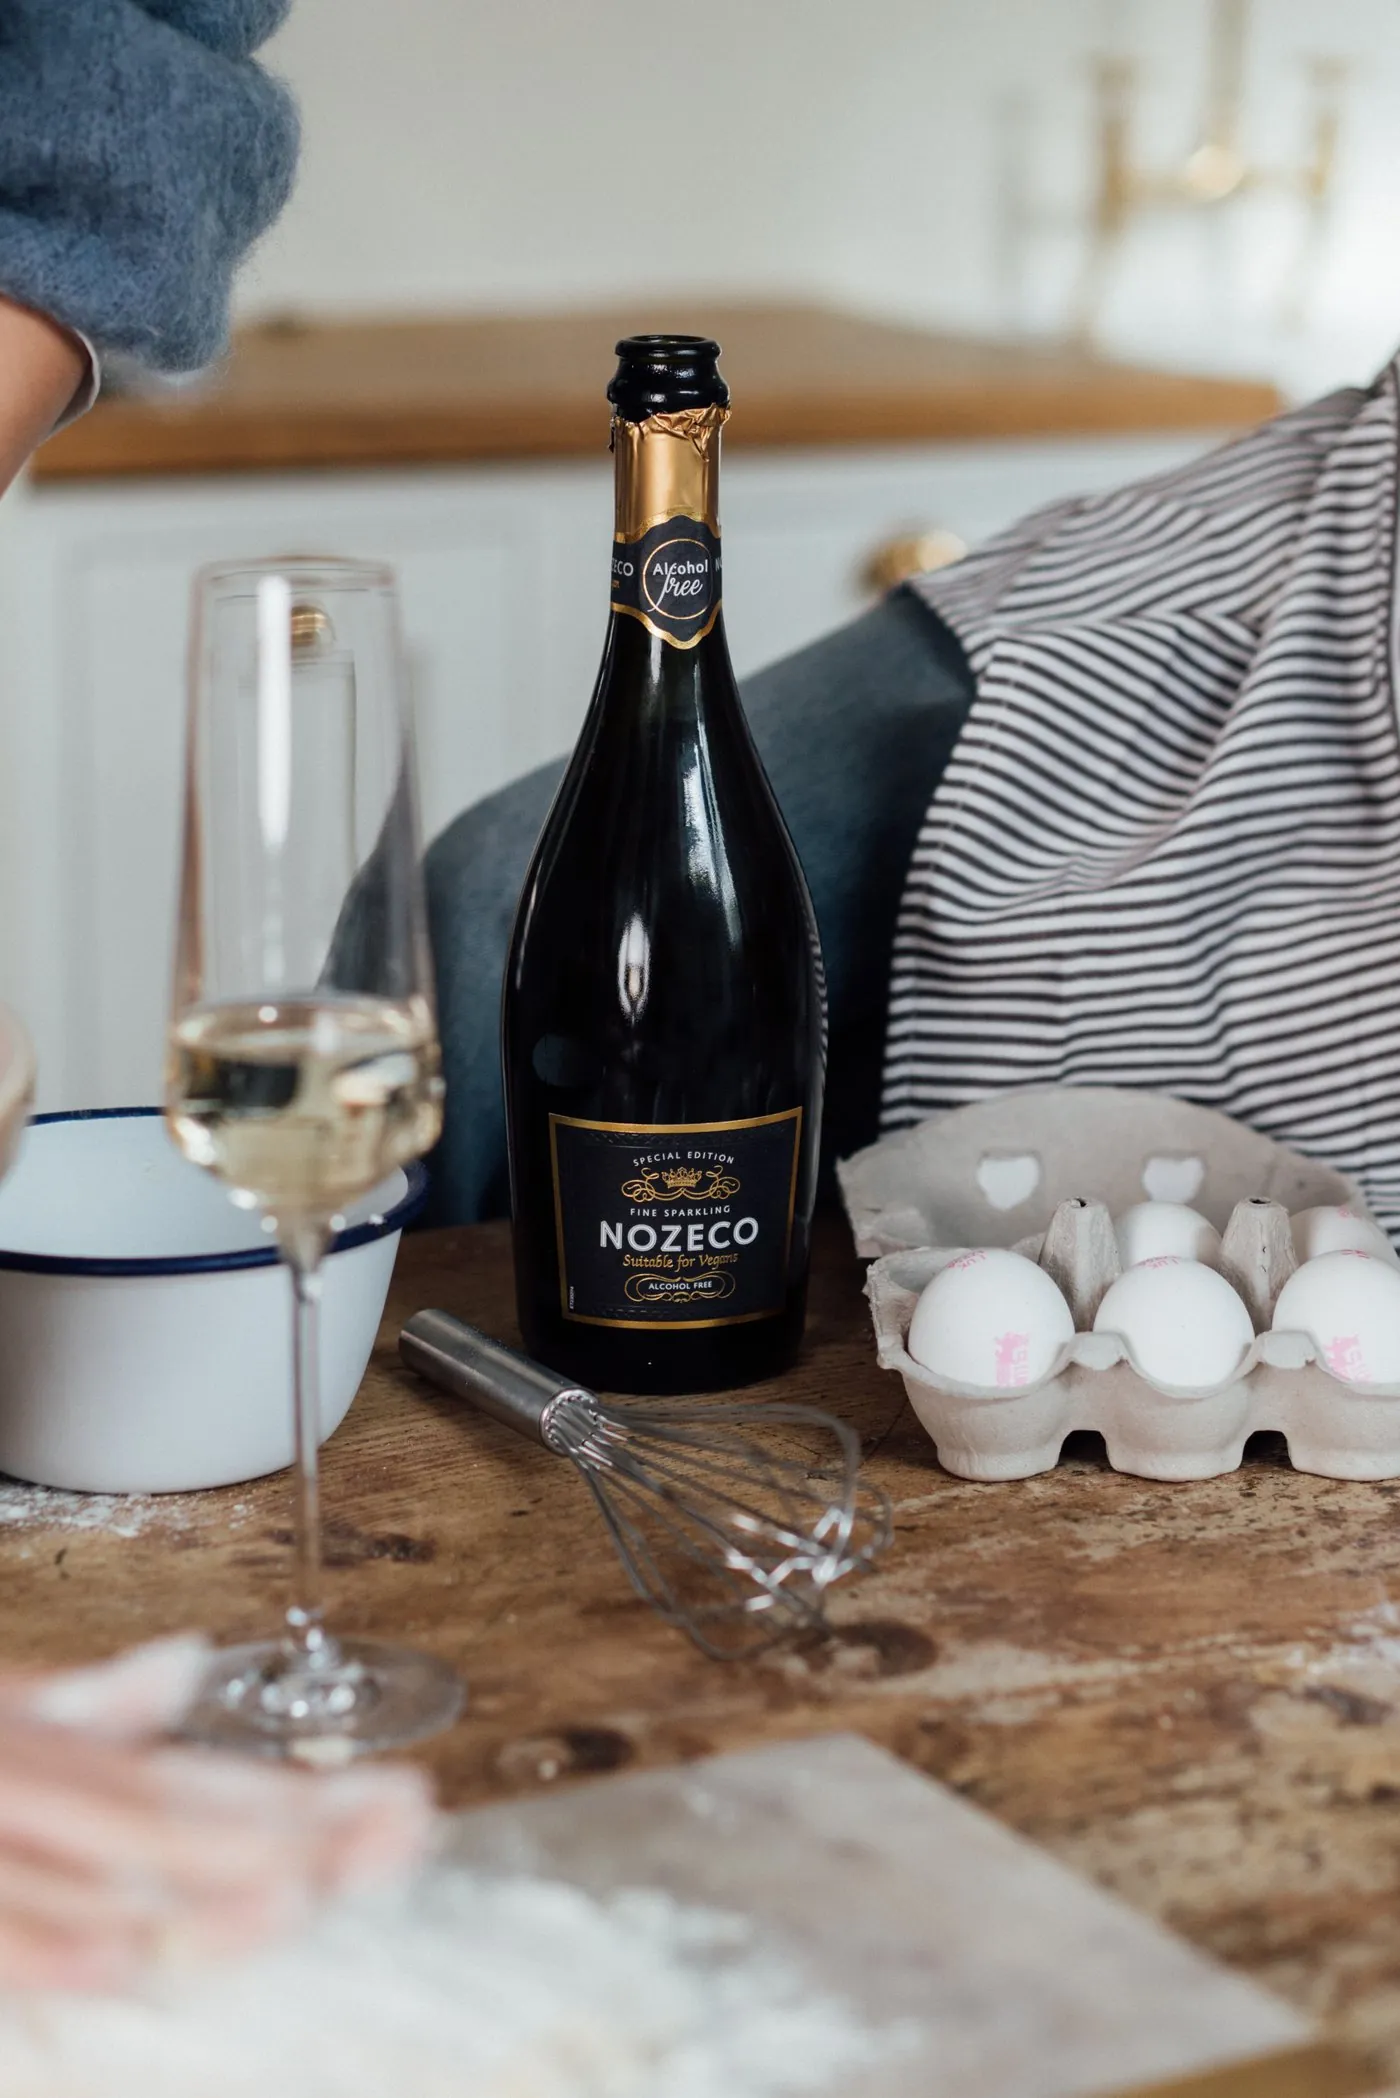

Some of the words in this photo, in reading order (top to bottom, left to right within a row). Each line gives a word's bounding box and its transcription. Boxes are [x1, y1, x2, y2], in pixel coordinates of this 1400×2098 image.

[652, 559, 708, 576] Alcohol
[647, 563, 704, 612] free
[633, 1151, 681, 1166] SPECIAL
[687, 1151, 735, 1164] EDITION
[630, 1208, 657, 1217] FINE
[664, 1205, 731, 1217] SPARKLING
[599, 1217, 759, 1252] NOZECO
[623, 1254, 673, 1268] Suitable
[675, 1255, 695, 1273] for
[699, 1252, 738, 1270] Vegans
[648, 1282, 690, 1290] ALCOHOL
[693, 1280, 713, 1289] FREE
